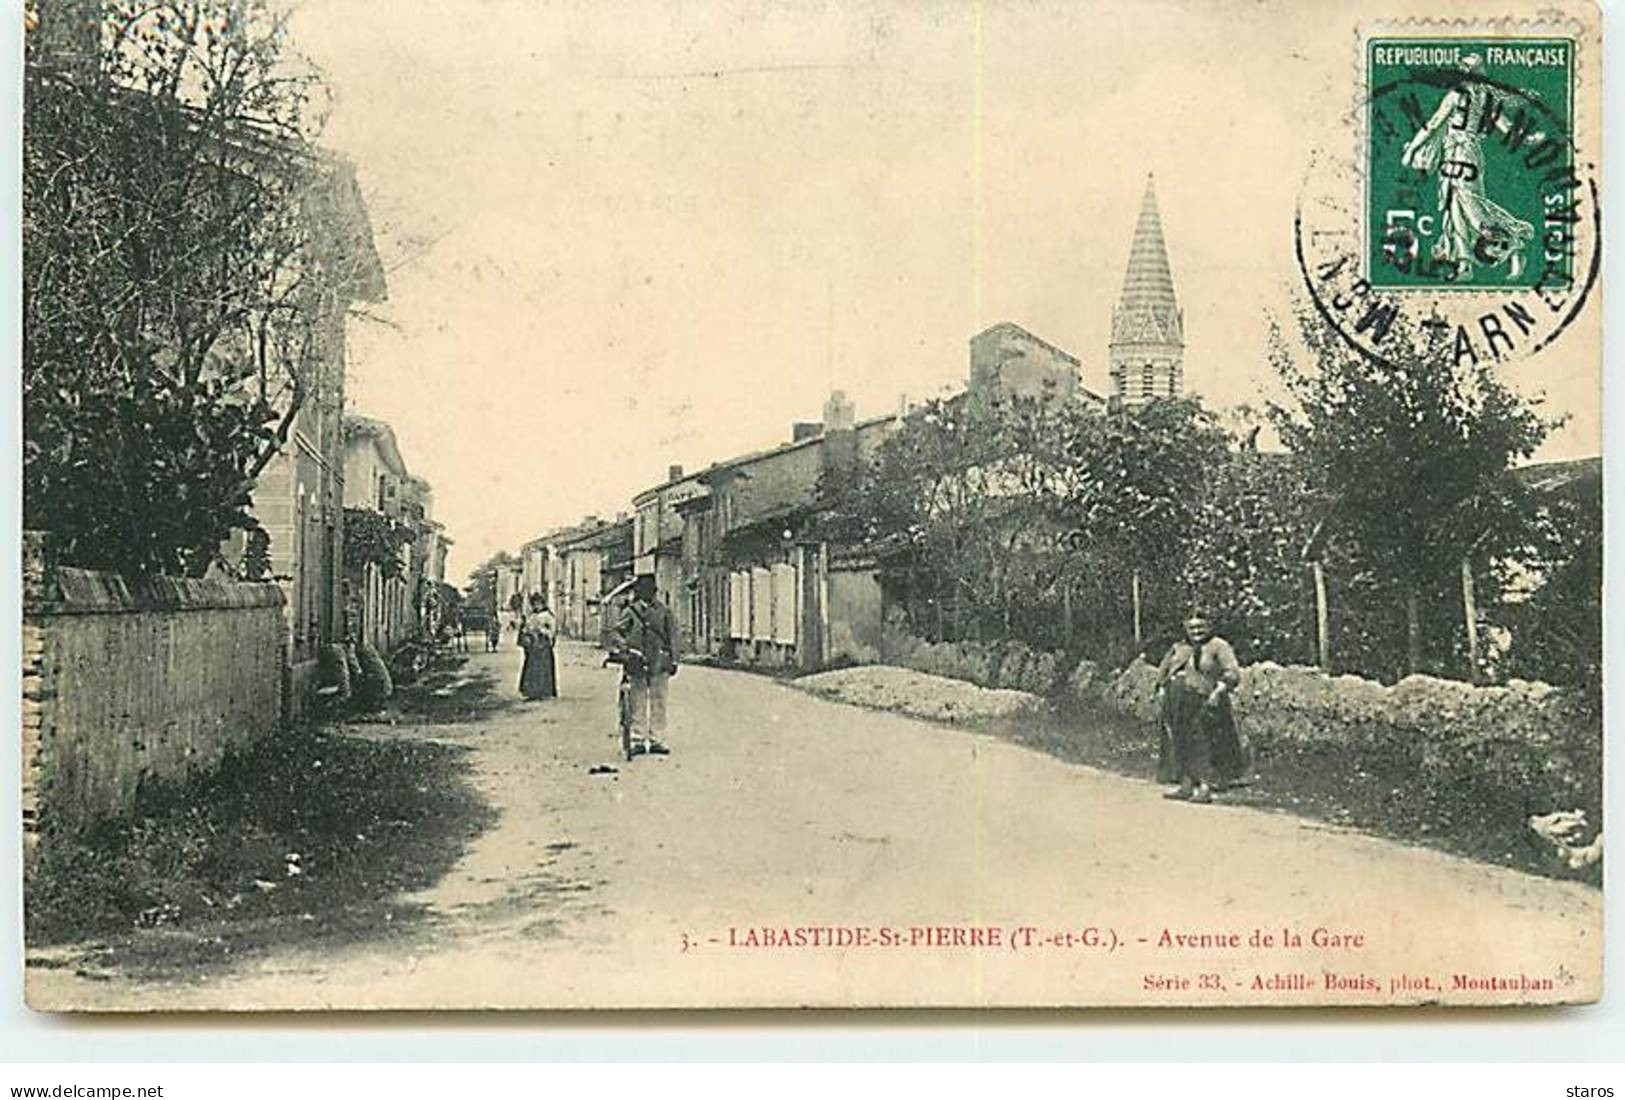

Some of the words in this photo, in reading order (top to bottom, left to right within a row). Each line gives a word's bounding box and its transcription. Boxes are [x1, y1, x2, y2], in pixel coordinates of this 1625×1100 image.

[1486, 47, 1566, 67] FRANÇAISE
[681, 930, 698, 953] 3.
[729, 926, 1002, 948] LABASTIDE-St-PIERRE
[1157, 928, 1241, 949] Avenue
[1248, 928, 1274, 949] de
[1283, 928, 1303, 949] la
[1311, 928, 1366, 949] Gare
[1143, 974, 1190, 992] Série
[1250, 973, 1316, 992] Achille
[1324, 973, 1380, 995] Bouis,
[1451, 973, 1555, 992] Montauban
